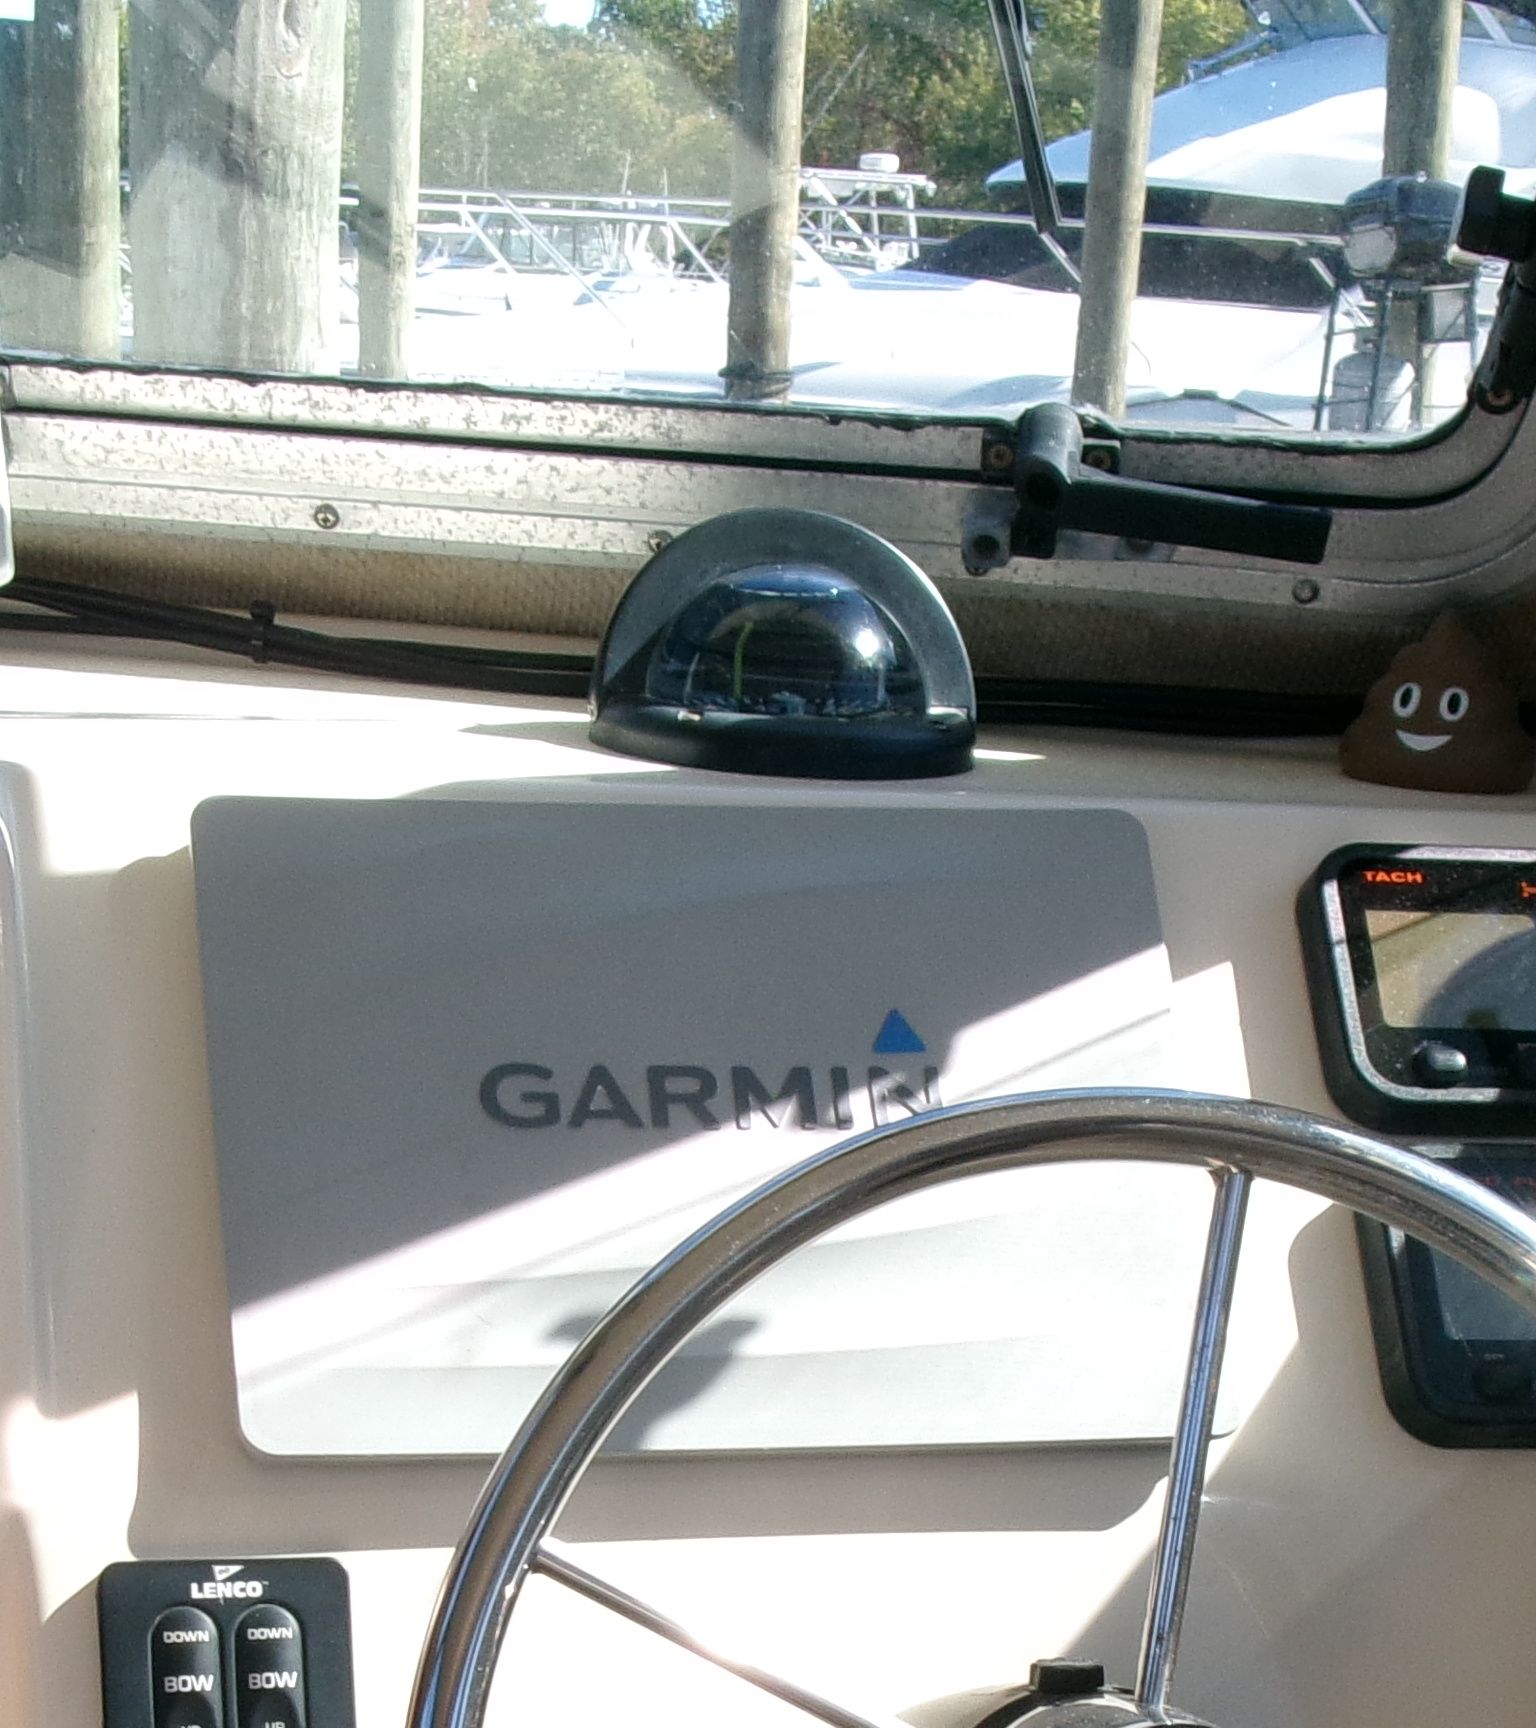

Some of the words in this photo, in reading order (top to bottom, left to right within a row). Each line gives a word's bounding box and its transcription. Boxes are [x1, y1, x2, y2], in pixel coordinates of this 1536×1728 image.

[1361, 870, 1424, 884] TACH
[478, 1061, 944, 1131] GARMIN
[190, 1580, 264, 1599] LENCO
[162, 1631, 210, 1643] DOWN
[247, 1627, 294, 1640] DOWN
[164, 1674, 214, 1693] BOW
[248, 1671, 298, 1689] BOW
